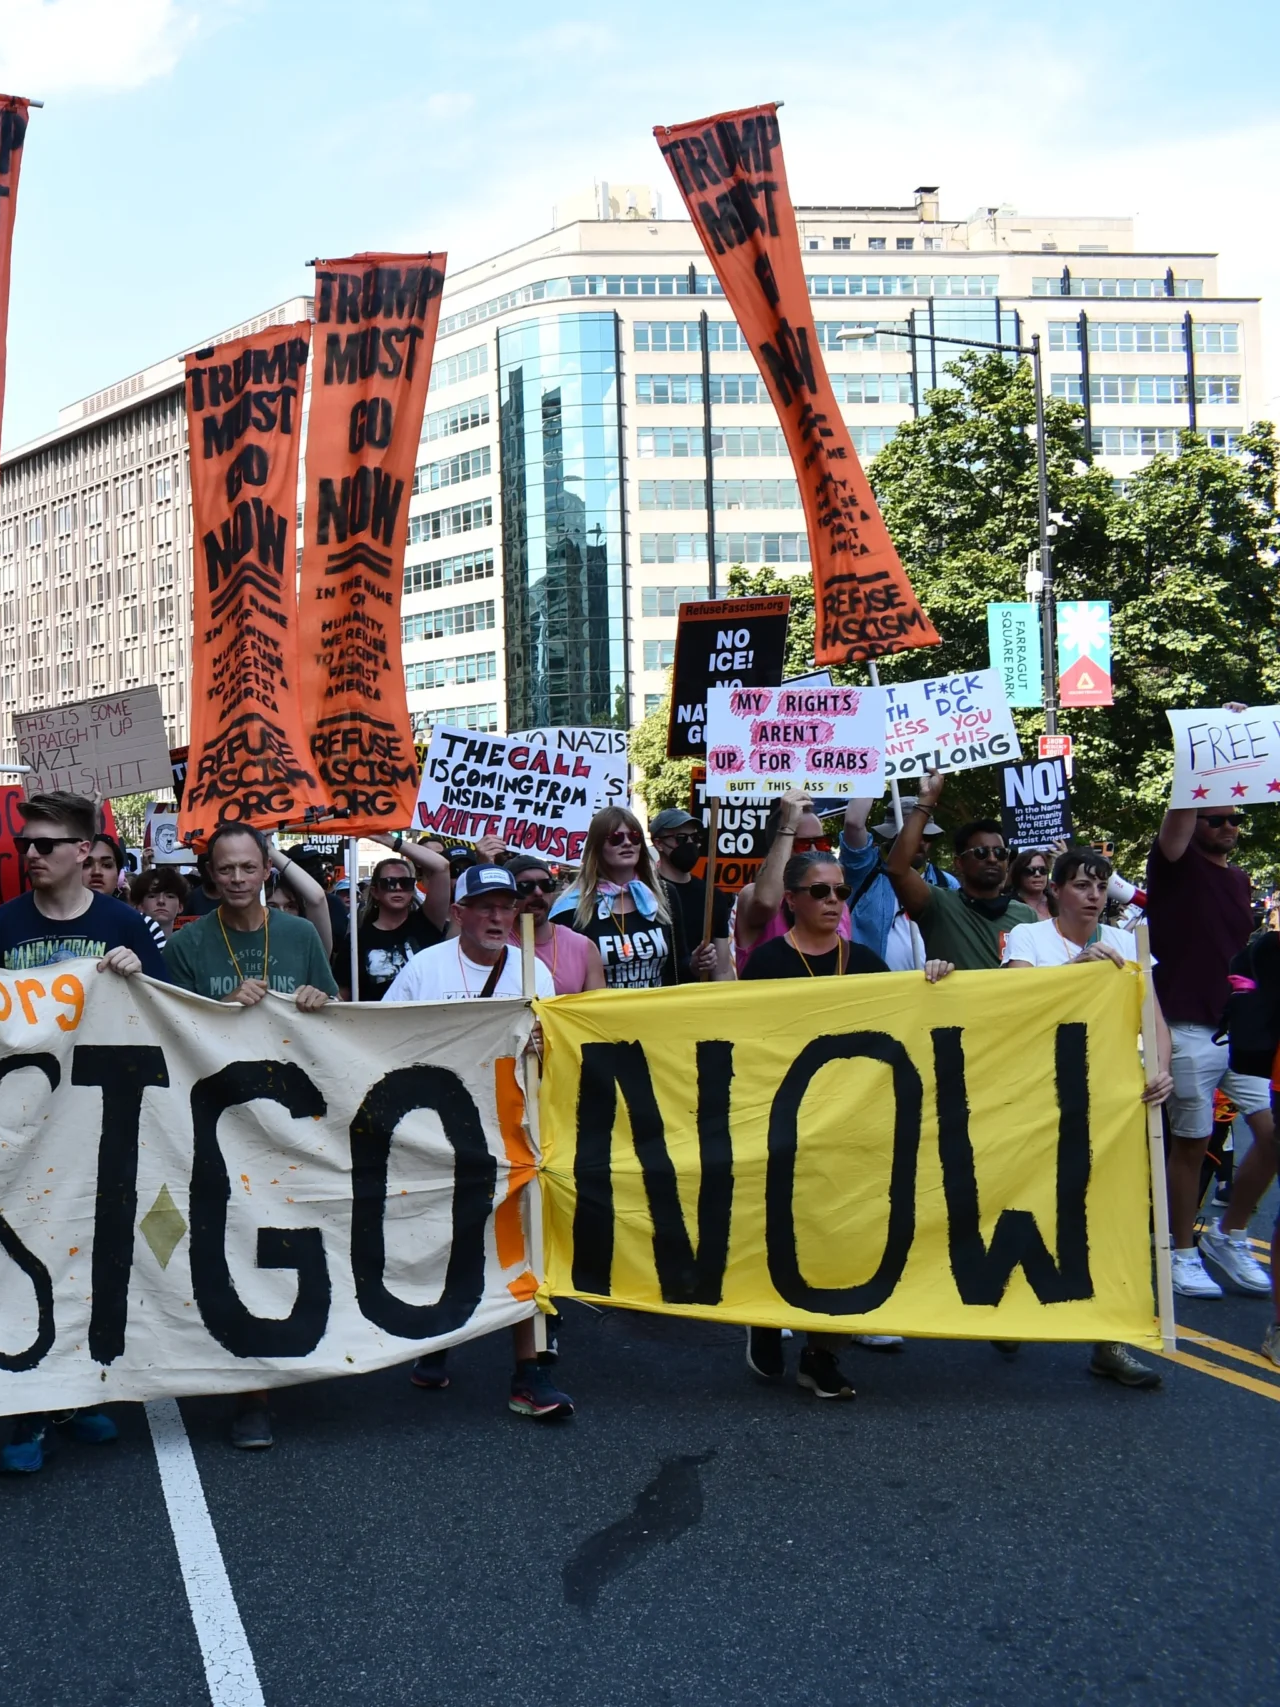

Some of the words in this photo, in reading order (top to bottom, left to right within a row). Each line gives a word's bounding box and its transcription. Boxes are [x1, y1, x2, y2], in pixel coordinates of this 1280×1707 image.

[661, 115, 781, 195] TRUMP
[316, 266, 445, 325] TRUMP
[324, 325, 425, 386] MUST
[186, 337, 310, 412] TRUMP
[203, 385, 298, 459] MUST
[348, 396, 394, 455] GO
[226, 443, 269, 502] GO
[316, 465, 405, 547] NOW
[203, 497, 288, 593] NOW
[316, 586, 336, 601] IN
[685, 600, 784, 617] RefuseFascism.org
[249, 595, 288, 629] NAME
[821, 608, 925, 650] FASCISM
[321, 634, 343, 649] WE
[716, 628, 750, 649] NO
[1001, 611, 1014, 660] SQUARE
[708, 650, 754, 672] ICE!
[1015, 620, 1029, 691] FARRAGUT
[206, 680, 225, 700] TO
[1004, 663, 1016, 700] PARK
[17, 713, 55, 735] THIS
[60, 708, 80, 727] IS
[91, 698, 133, 722] SOME
[737, 694, 763, 712] MY
[785, 693, 852, 713] RIGHTS
[936, 695, 980, 716] D.C.
[950, 709, 993, 731] YOU
[20, 724, 102, 754] STRAIGHT
[109, 717, 133, 738] UP
[310, 727, 405, 761] REFUSE
[557, 729, 626, 754] NAZIS
[758, 725, 819, 743] AREN'T
[936, 725, 991, 749] THIS
[1187, 720, 1269, 770] FREE
[21, 745, 83, 775] NAZI
[197, 727, 299, 781] REFUSE
[441, 733, 507, 767] THE
[508, 746, 591, 778] CALL
[715, 752, 737, 770] UP
[759, 752, 791, 770] FOR
[811, 751, 868, 770] GRABS
[885, 732, 1011, 777] OOTLONG
[25, 758, 149, 797] BULLSHIT
[187, 758, 317, 812] FASCISM
[429, 758, 449, 783] IS
[451, 763, 533, 794] COMING
[535, 779, 587, 807] FROM
[729, 781, 756, 792] BUTT
[767, 781, 792, 792] THIS
[804, 781, 825, 792] ASS
[838, 783, 849, 793] IS
[1003, 759, 1066, 807] NO!
[442, 786, 506, 811] INSIDE
[513, 798, 565, 819] THE
[702, 808, 771, 831] MUST
[1015, 814, 1024, 822] of
[1025, 811, 1062, 822] Humanity
[1025, 805, 1039, 813] the
[1040, 803, 1061, 812] Name
[417, 801, 502, 838] WHITE
[503, 817, 588, 861] HOUSE
[1008, 836, 1039, 845] Fascist
[1040, 833, 1070, 843] America
[1028, 828, 1057, 837] Accept
[1033, 818, 1062, 828] REFUSE
[717, 832, 754, 854] GO
[599, 928, 669, 965] FUCK
[245, 963, 263, 971] THE
[571, 1021, 1094, 1316] NOW
